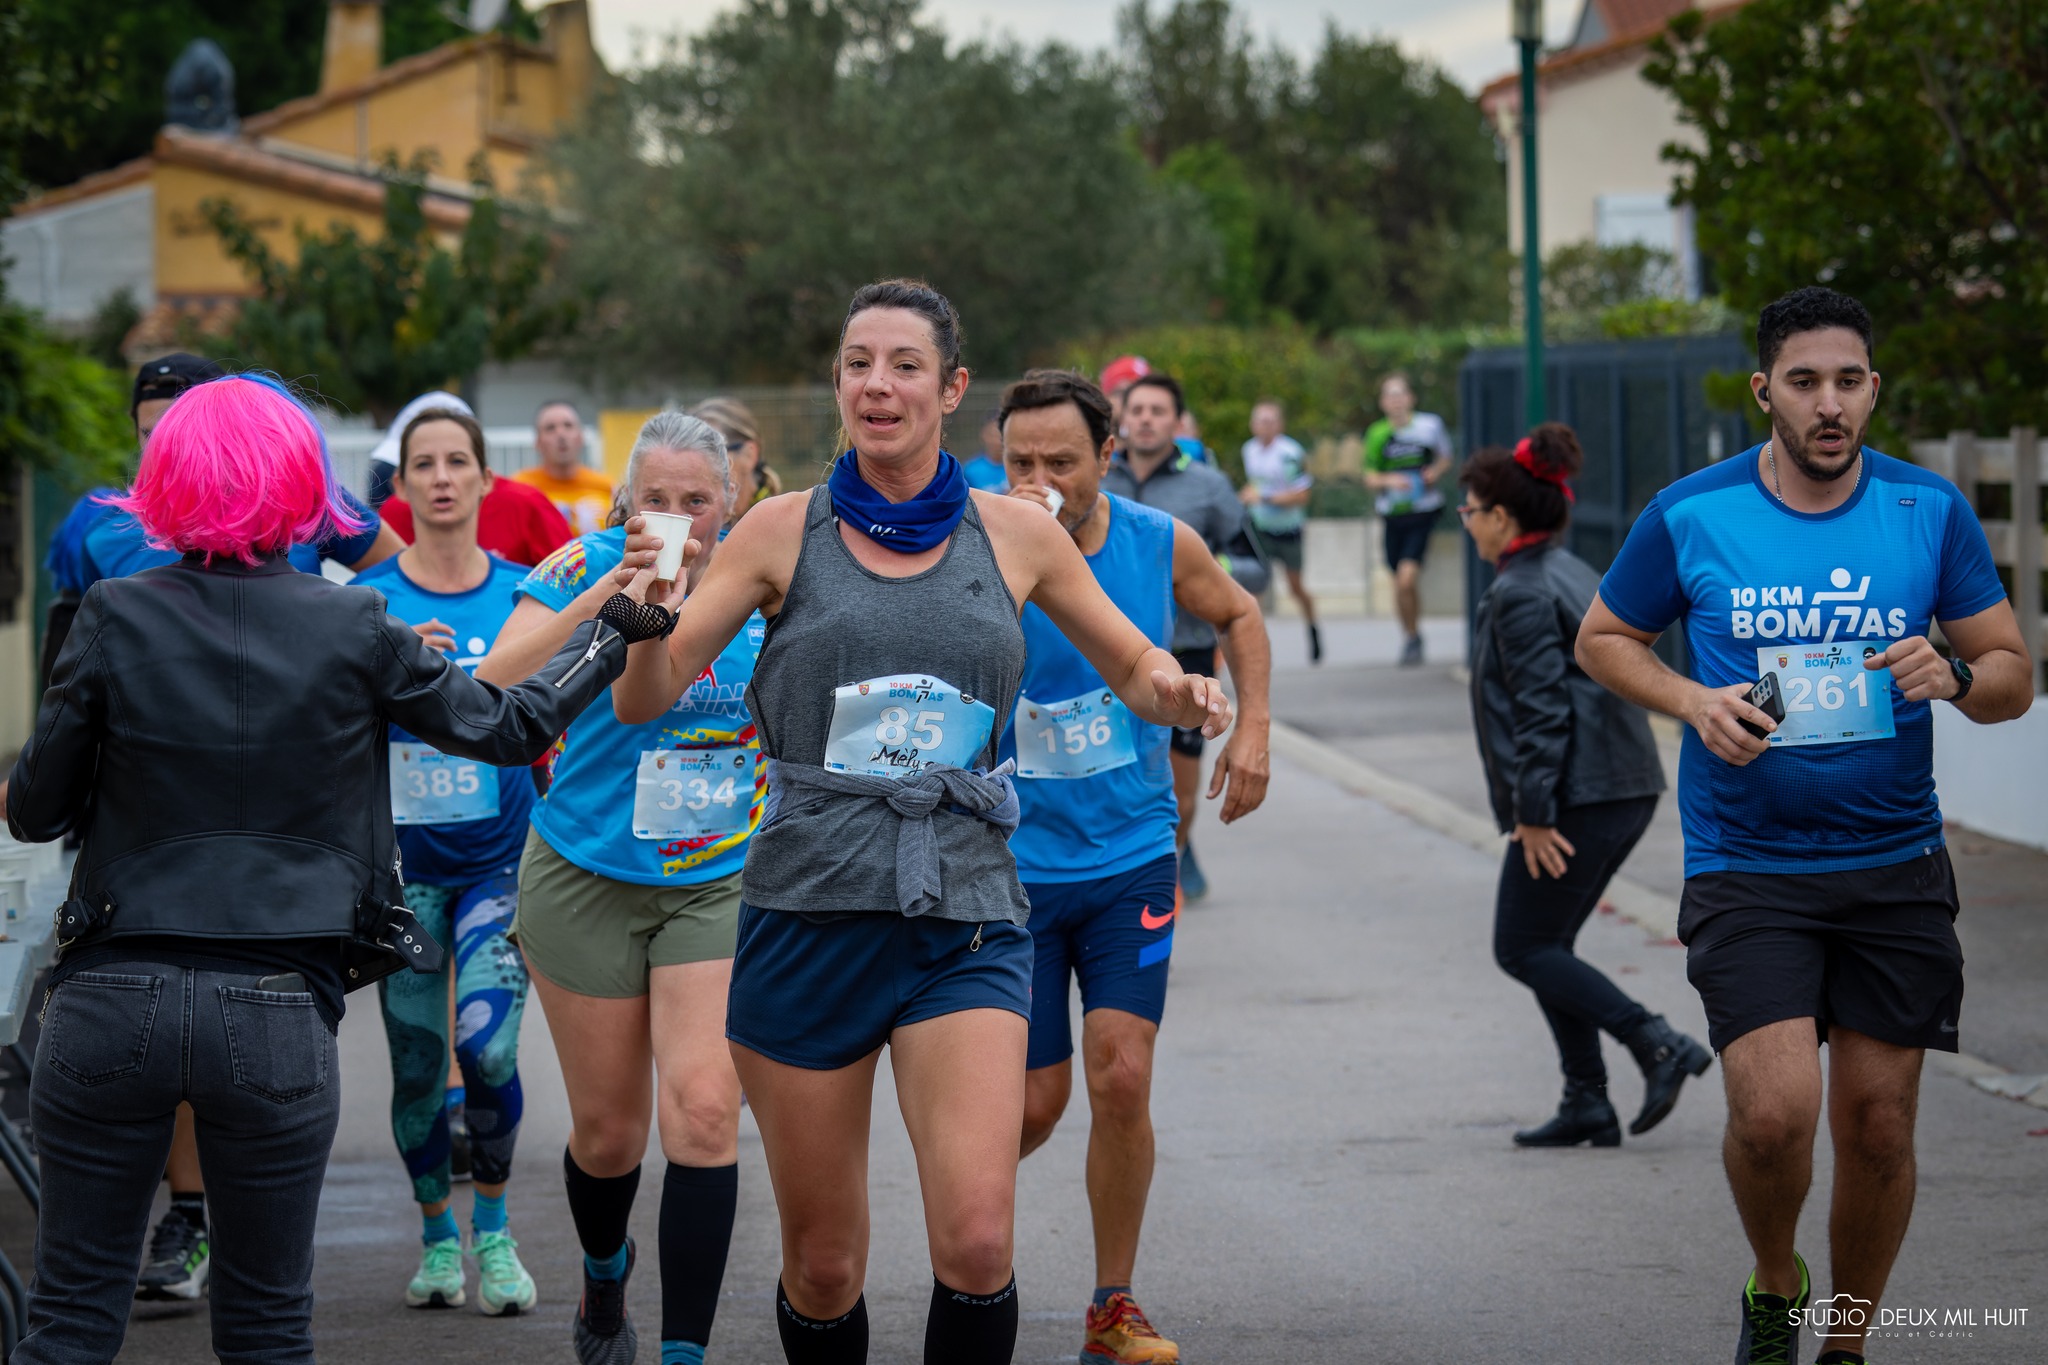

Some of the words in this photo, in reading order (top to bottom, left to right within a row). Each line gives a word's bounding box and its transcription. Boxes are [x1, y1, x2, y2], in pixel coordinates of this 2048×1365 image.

[1730, 587, 1756, 608] 10
[1761, 586, 1804, 607] KM
[1785, 672, 1869, 713] 261
[875, 706, 945, 751] 85
[1038, 715, 1112, 755] 156
[407, 764, 480, 799] 385
[657, 777, 737, 811] 334
